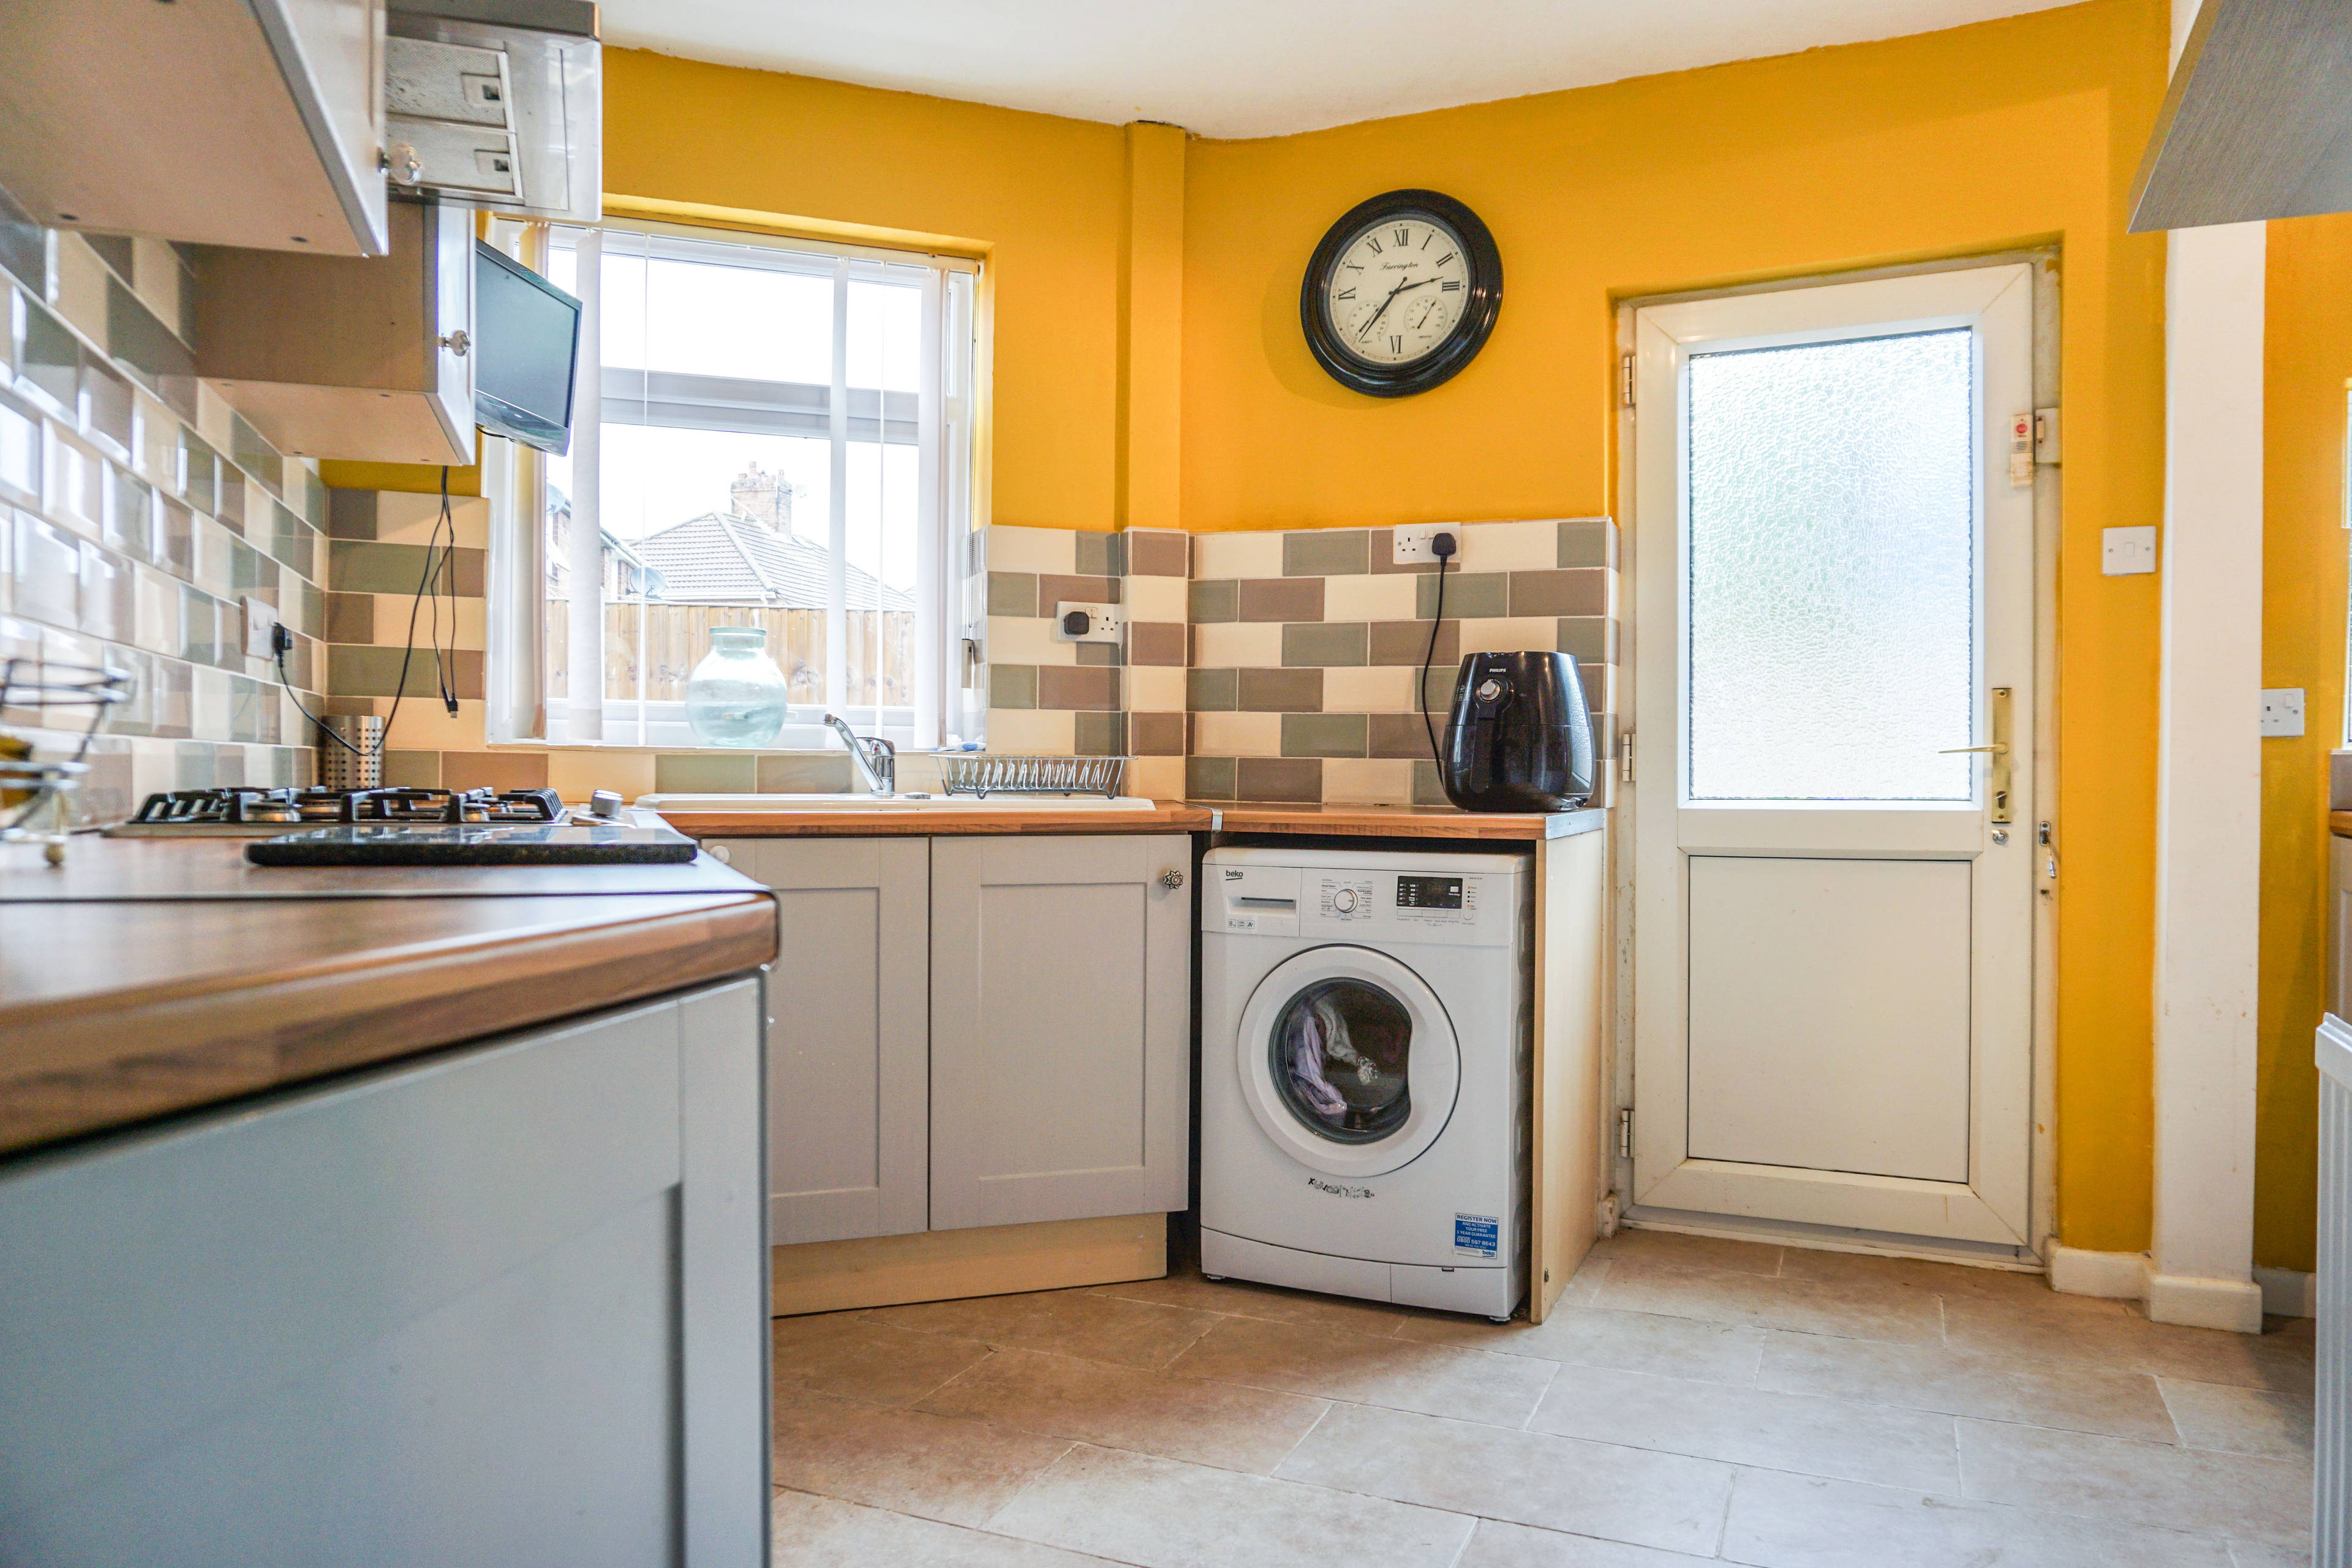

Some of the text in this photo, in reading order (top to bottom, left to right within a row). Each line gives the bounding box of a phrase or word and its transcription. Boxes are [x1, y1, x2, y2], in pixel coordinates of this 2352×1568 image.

[1393, 228, 1409, 247] XII
[1366, 238, 1382, 258] XI
[1346, 260, 1364, 275] X
[1380, 262, 1419, 270] Farrington
[1436, 252, 1454, 268] II
[1441, 279, 1460, 293] III
[1338, 287, 1356, 301] IX
[1390, 335, 1403, 355] VI
